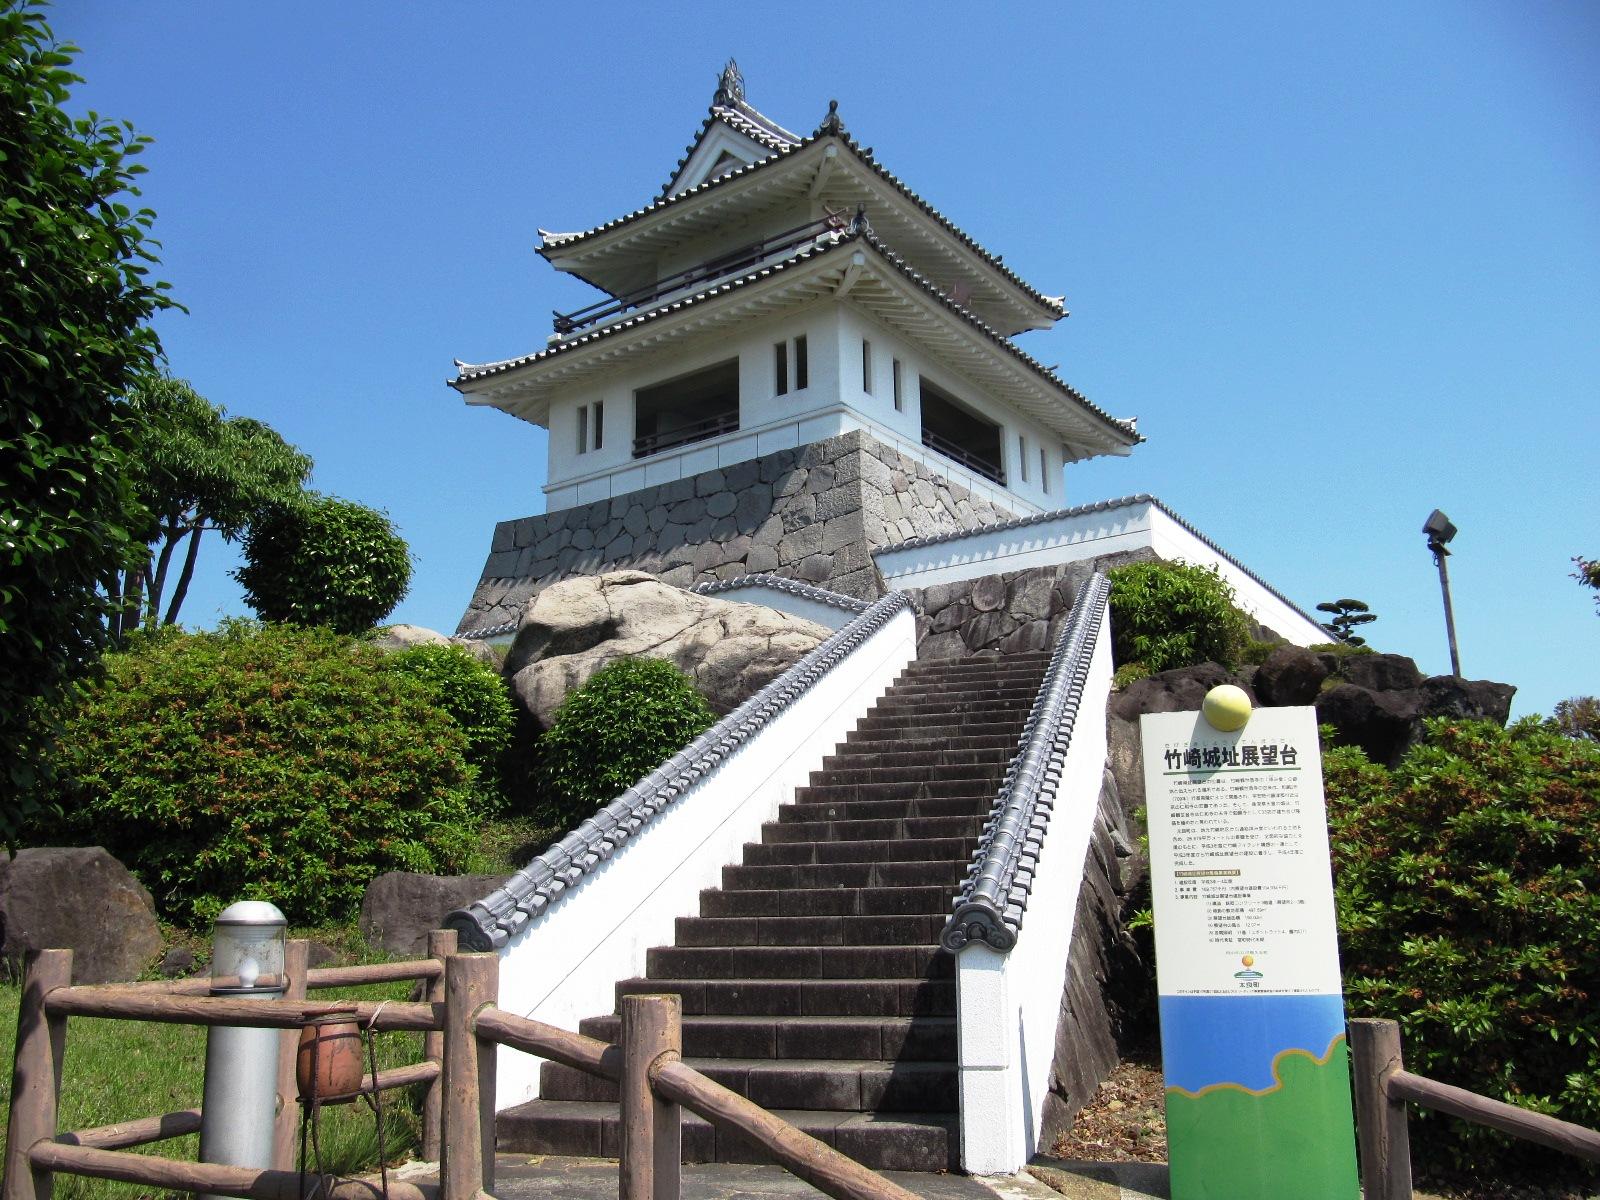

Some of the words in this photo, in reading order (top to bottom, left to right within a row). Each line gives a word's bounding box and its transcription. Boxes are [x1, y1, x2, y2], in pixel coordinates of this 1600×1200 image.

[1164, 744, 1298, 769] 竹崎城址展望台
